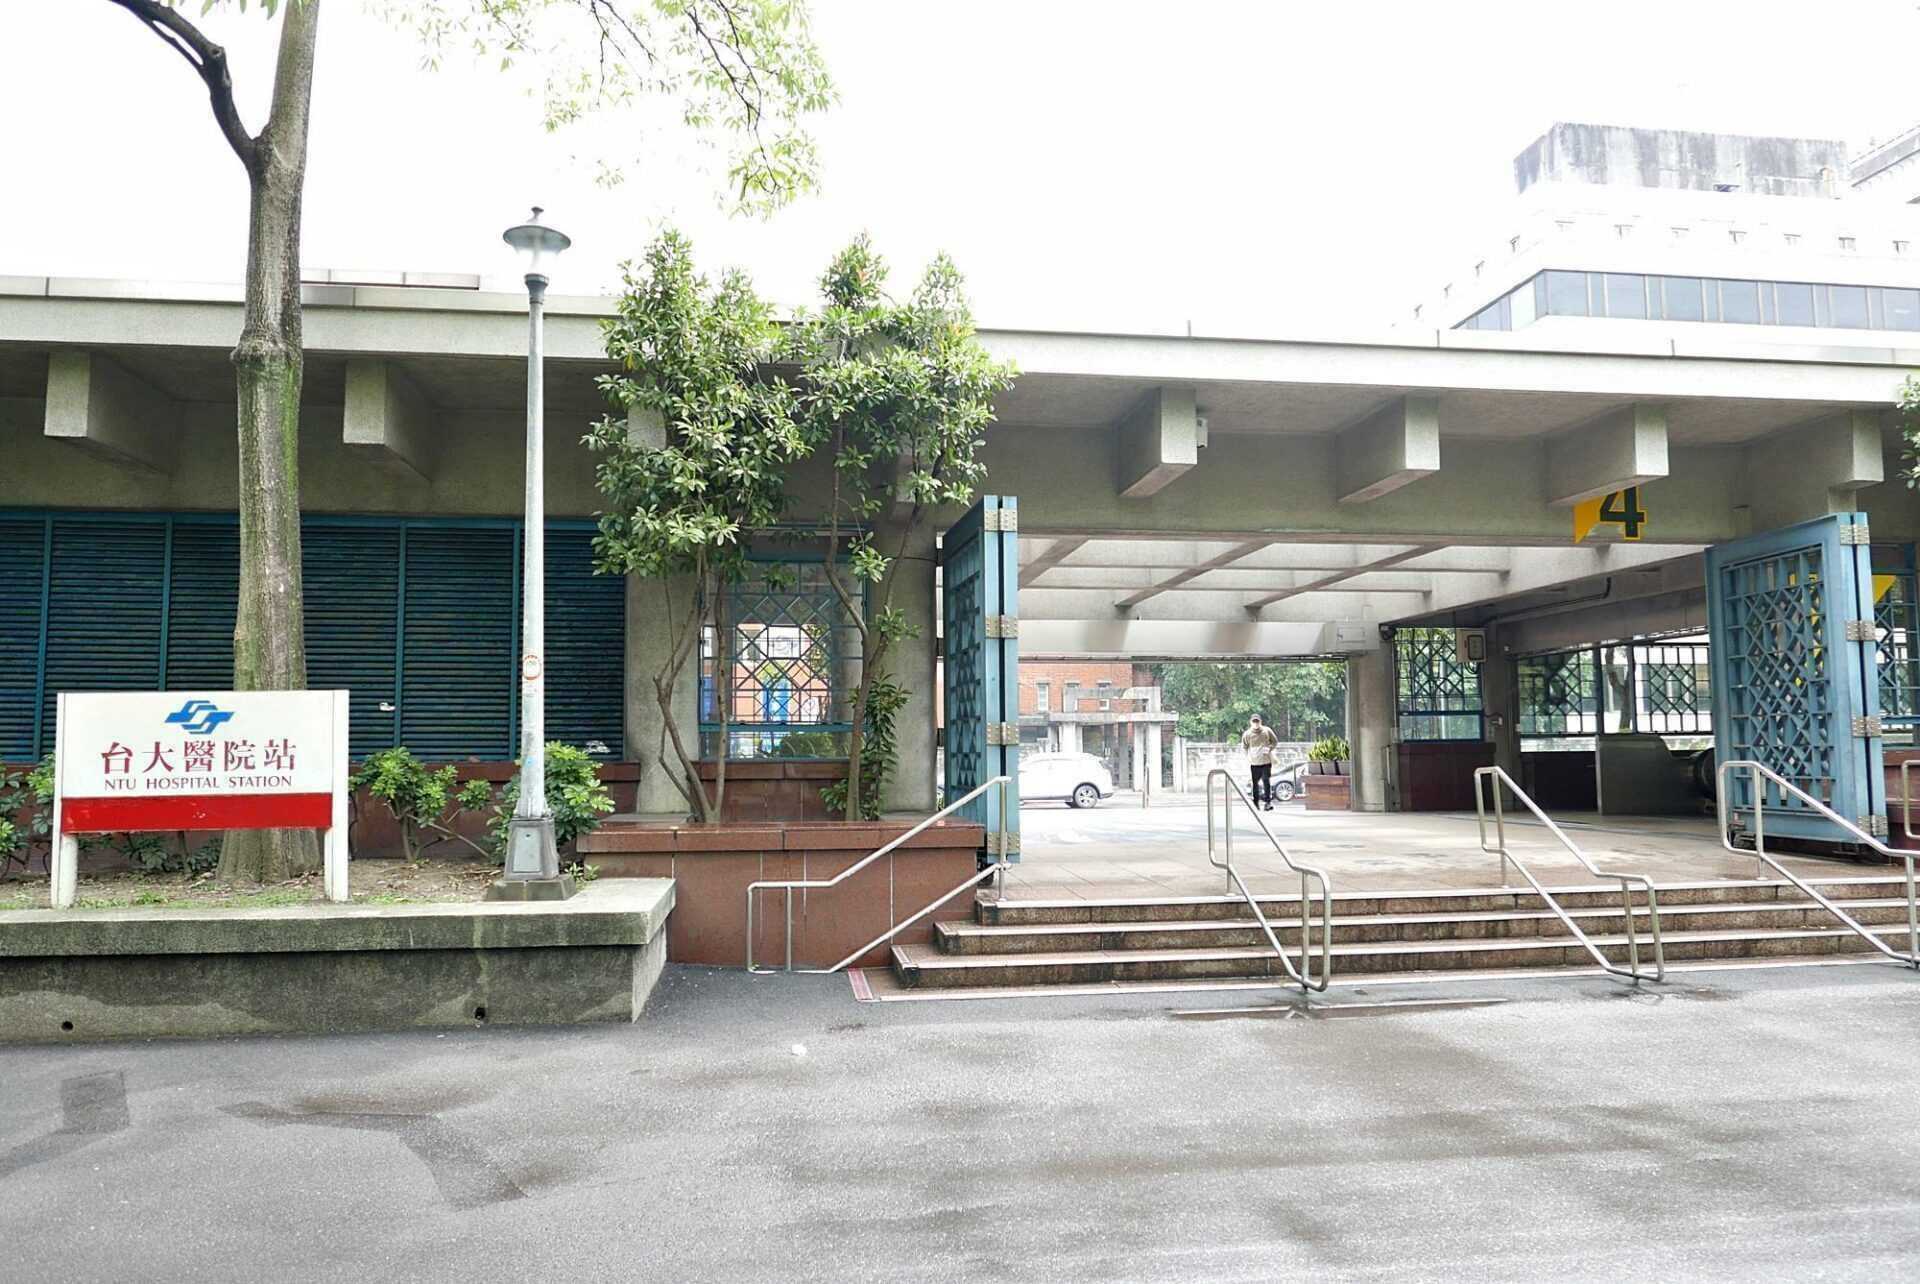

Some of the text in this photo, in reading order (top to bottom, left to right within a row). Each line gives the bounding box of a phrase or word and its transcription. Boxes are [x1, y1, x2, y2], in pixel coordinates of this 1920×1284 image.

[1599, 486, 1647, 539] 4
[101, 738, 297, 774] 台大醫院站
[104, 775, 292, 791] NTU HOSPITAL STATION
